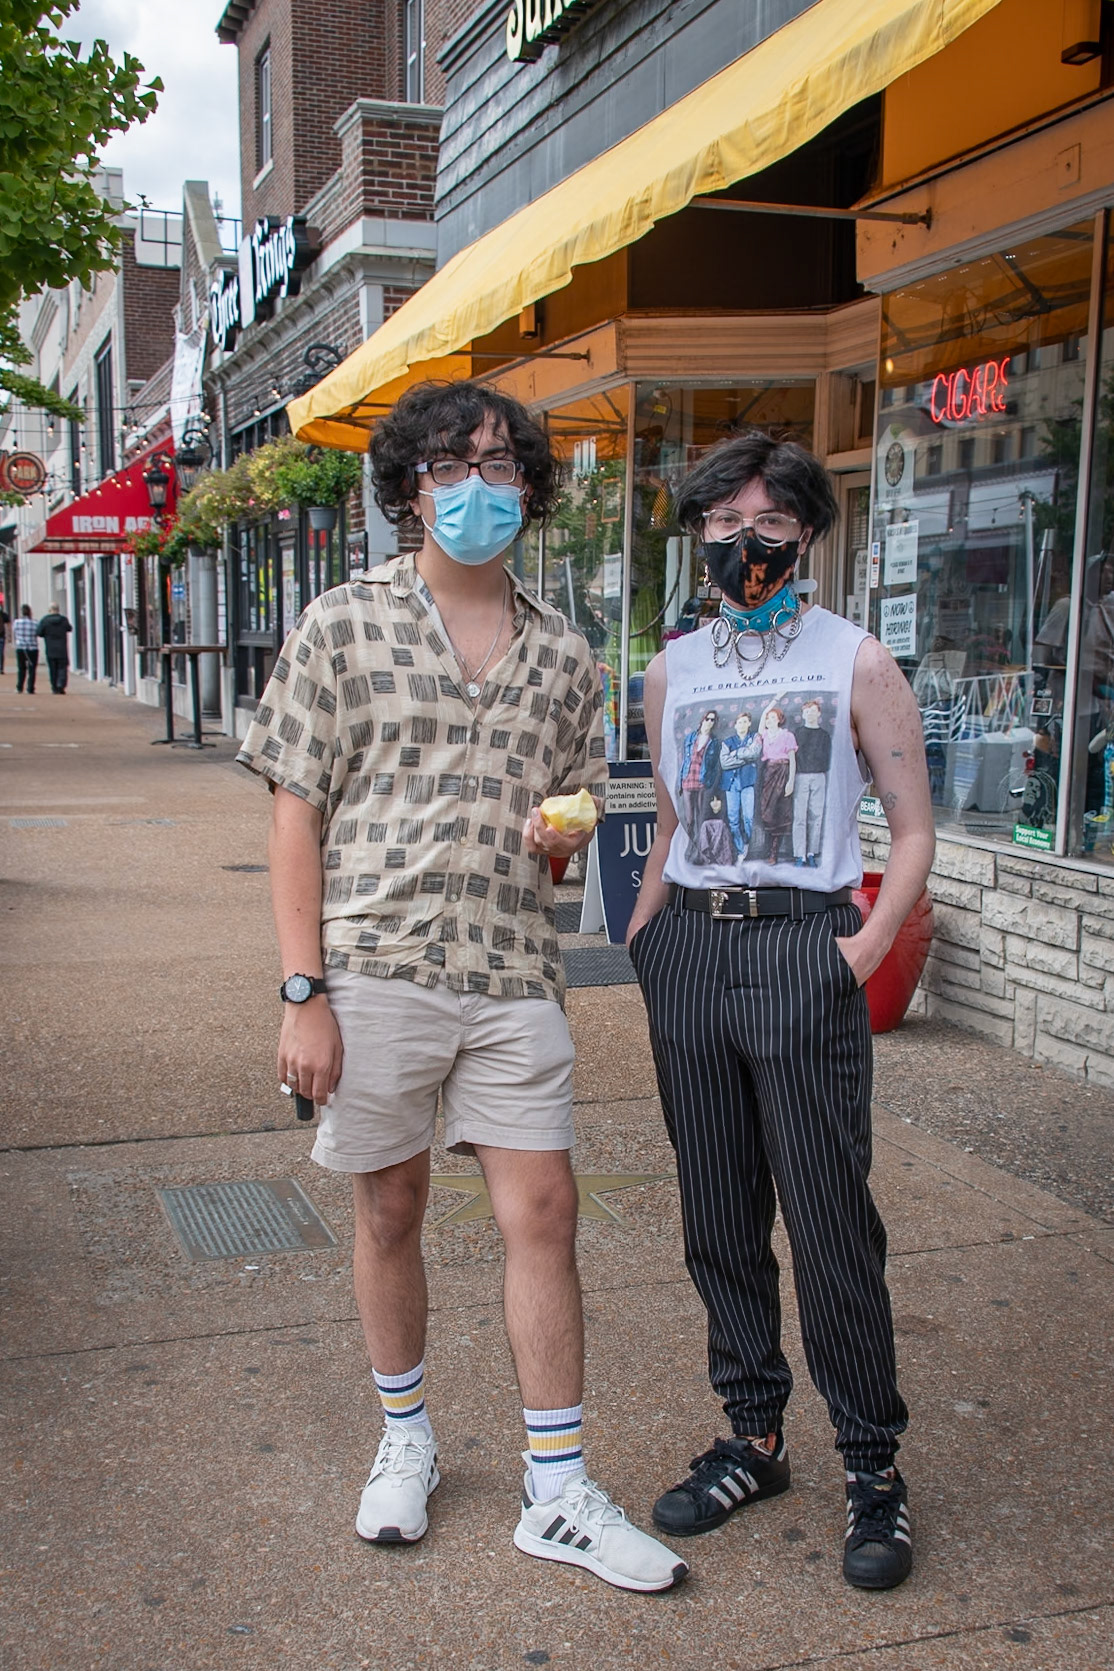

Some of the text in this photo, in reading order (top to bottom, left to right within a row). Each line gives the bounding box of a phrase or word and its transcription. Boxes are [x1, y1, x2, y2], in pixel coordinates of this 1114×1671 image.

[72, 516, 120, 533] IRON
[890, 602, 908, 617] NOW
[692, 684, 713, 694] THE
[717, 677, 785, 690] BREAKFAST
[609, 782, 647, 790] WARNING:
